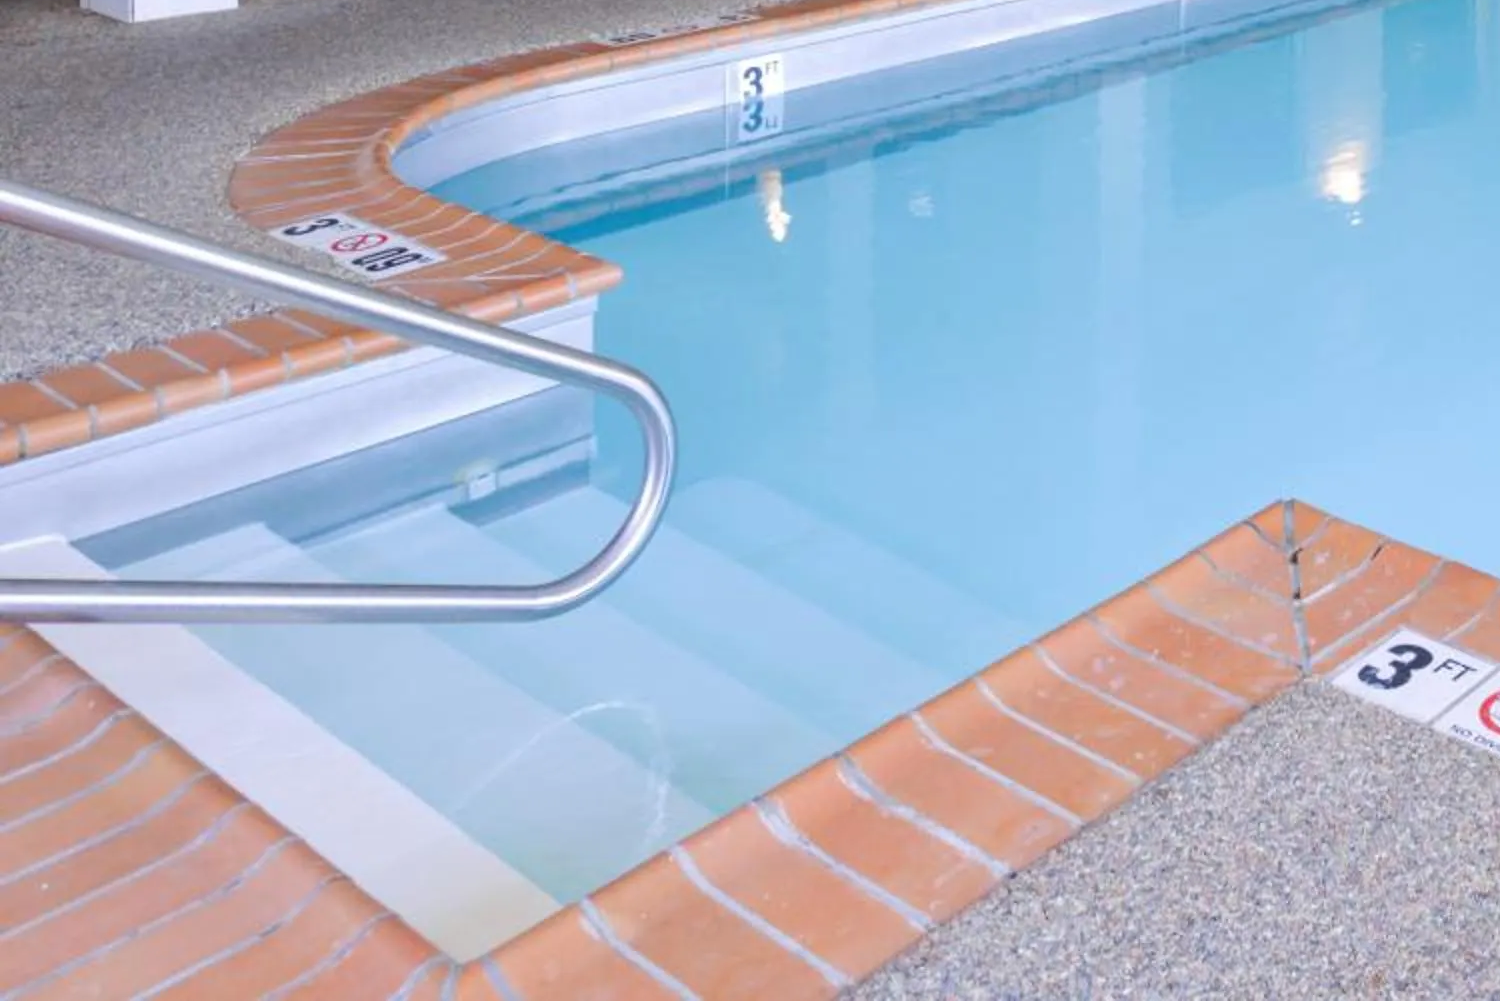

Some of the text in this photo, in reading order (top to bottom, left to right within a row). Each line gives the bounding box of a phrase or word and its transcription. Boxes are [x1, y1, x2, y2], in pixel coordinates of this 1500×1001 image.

[743, 66, 763, 99] 3
[282, 217, 340, 236] 3
[1357, 643, 1478, 690] 3 FT
[1450, 724, 1473, 737] NO
